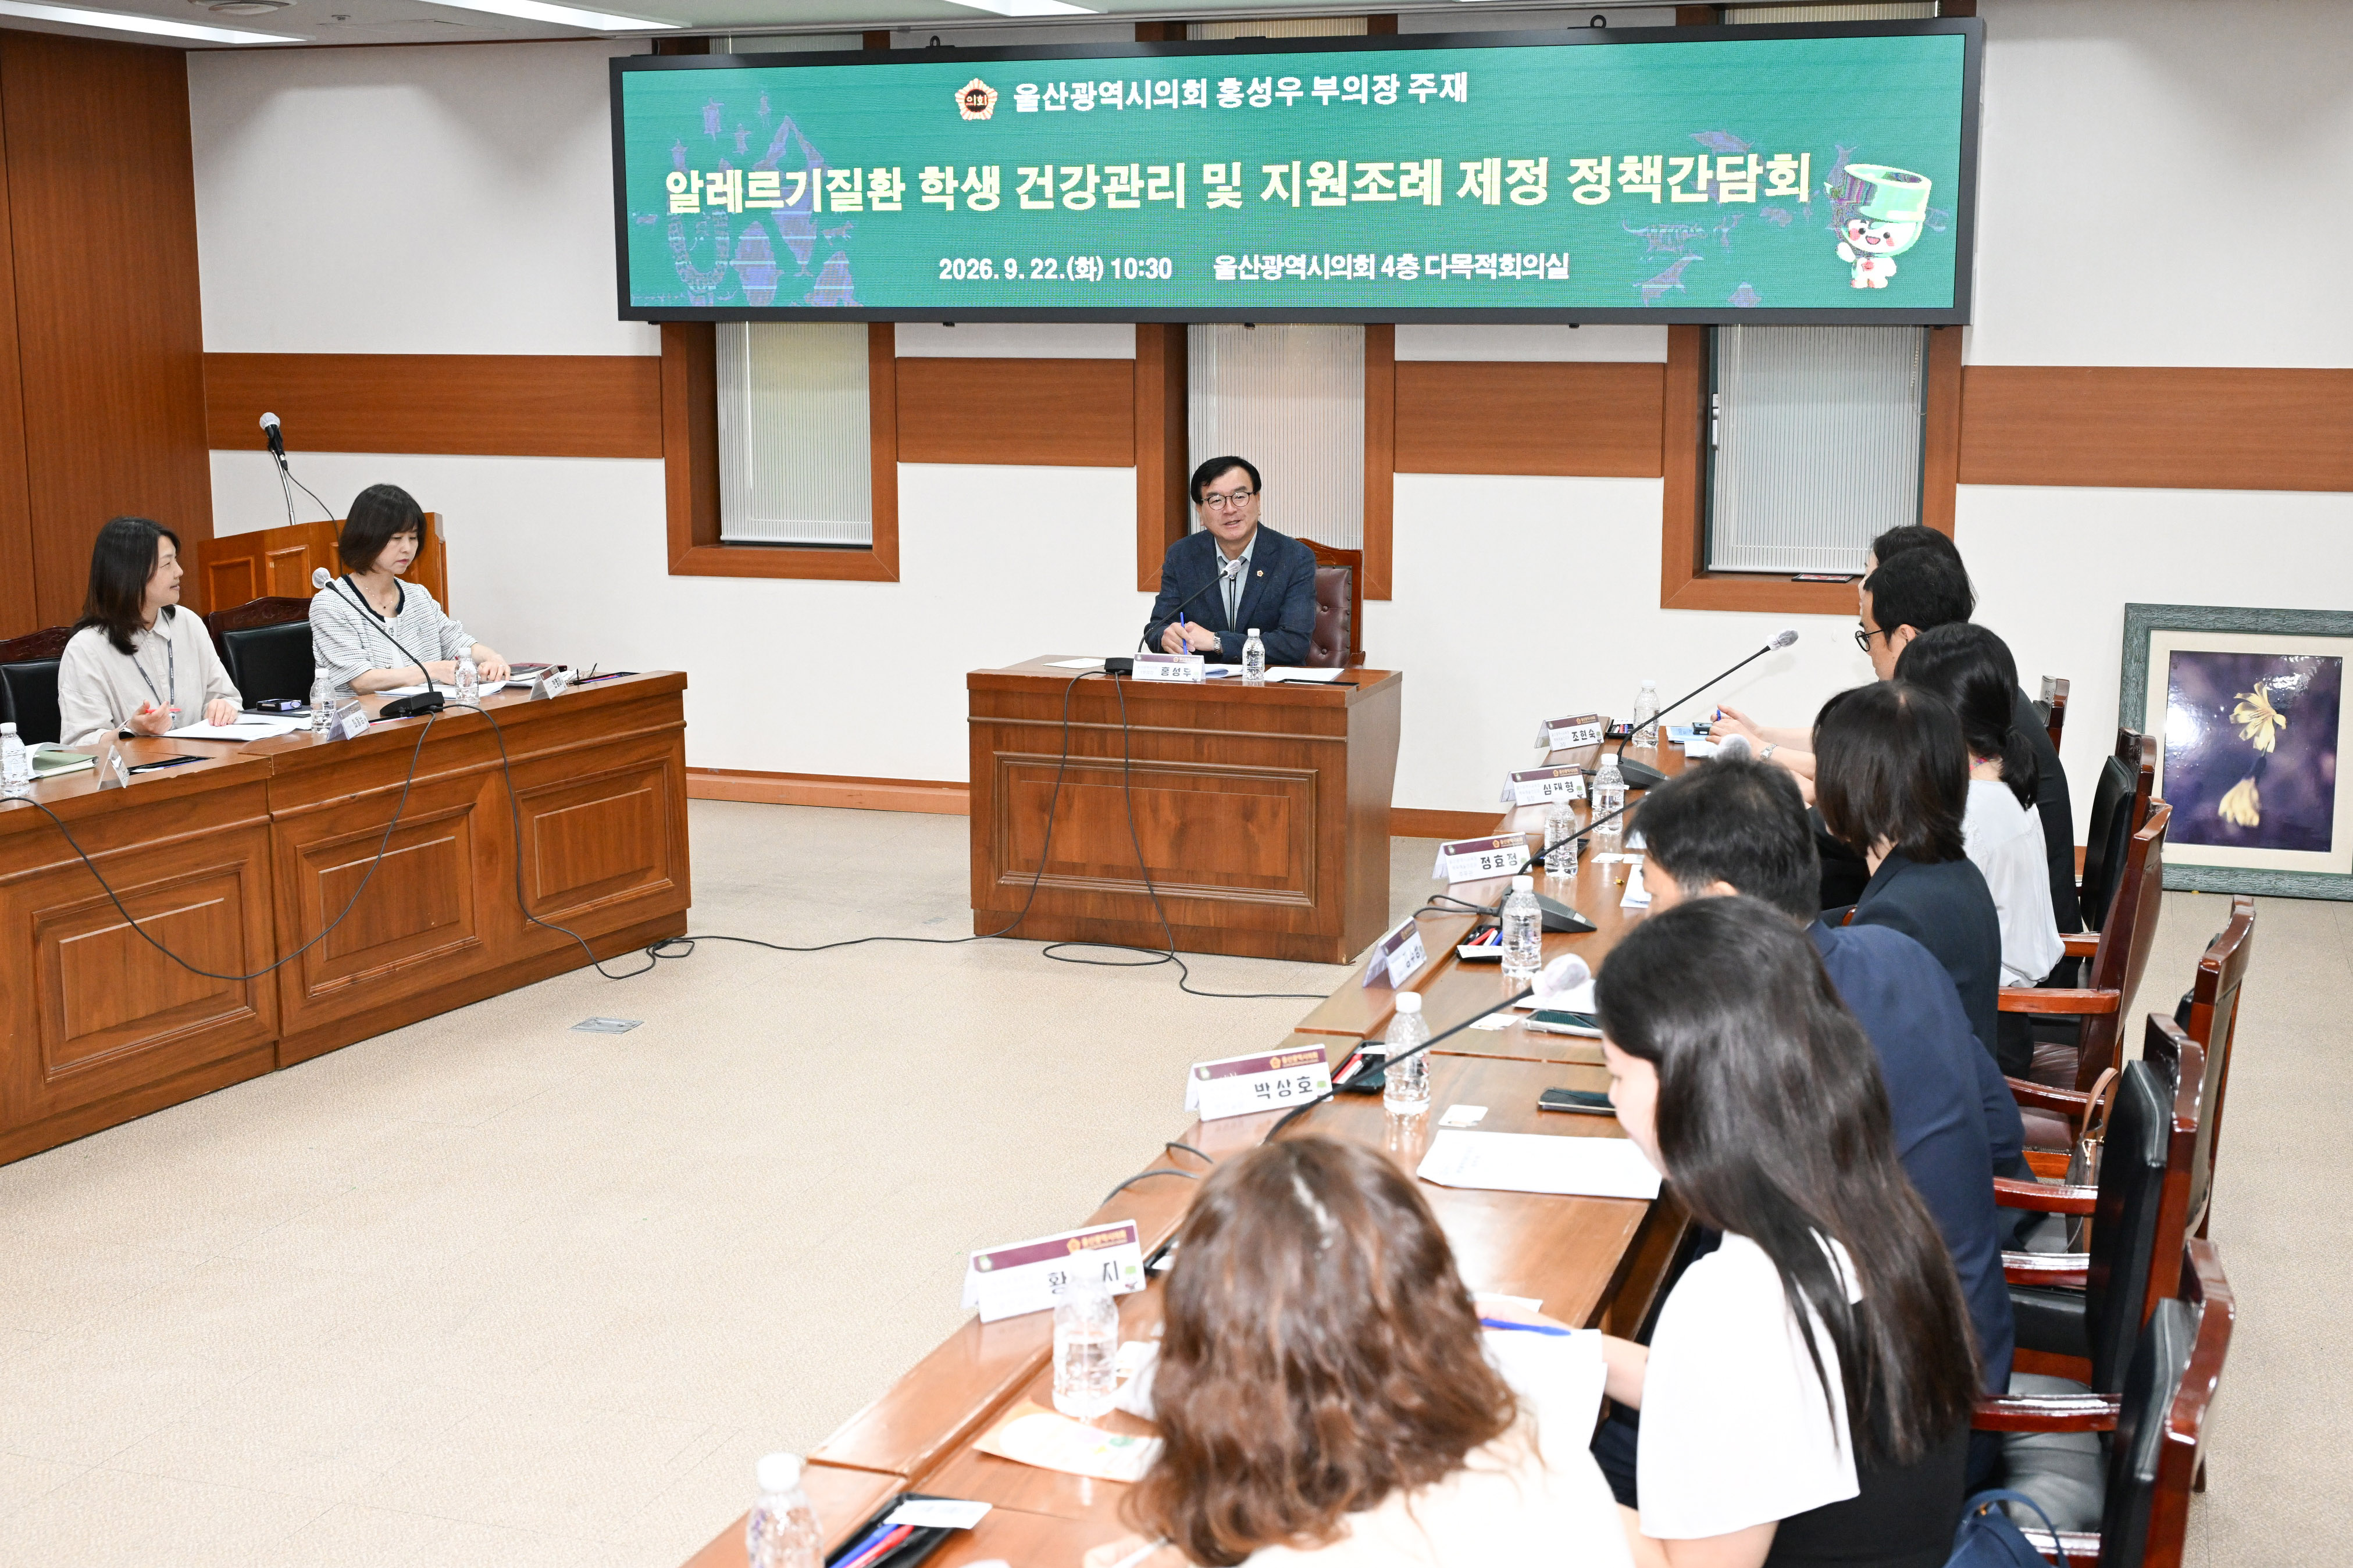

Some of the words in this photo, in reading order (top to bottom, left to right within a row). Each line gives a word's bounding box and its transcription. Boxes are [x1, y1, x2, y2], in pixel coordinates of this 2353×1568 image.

[965, 94, 987, 106] 의회
[1014, 78, 1207, 112] 울산광역시의회
[1216, 77, 1304, 108] 홍성우
[1311, 74, 1400, 105] 부의장
[1408, 72, 1468, 103] 주재
[666, 166, 905, 213] 알레르기질환
[919, 165, 1000, 212] 학생
[1016, 162, 1185, 210] 건강관리
[1203, 161, 1243, 209] 및
[1260, 158, 1442, 207] 지원조례
[1457, 157, 1548, 206] 제정
[1567, 153, 1810, 205] 정책간담회
[939, 258, 999, 280] 2026.
[1004, 258, 1025, 280] 9.
[1031, 256, 1104, 282] 22.(화)
[1111, 258, 1172, 280] 10:30
[1213, 254, 1375, 280] 울산광역시의회
[1381, 253, 1420, 280] 4층
[1425, 252, 1569, 280] 다목적회의실
[1161, 666, 1192, 677] 홍성우
[1480, 852, 1518, 870] 정효정
[1254, 1076, 1313, 1099] 박상호
[1047, 1260, 1119, 1294] 황지
